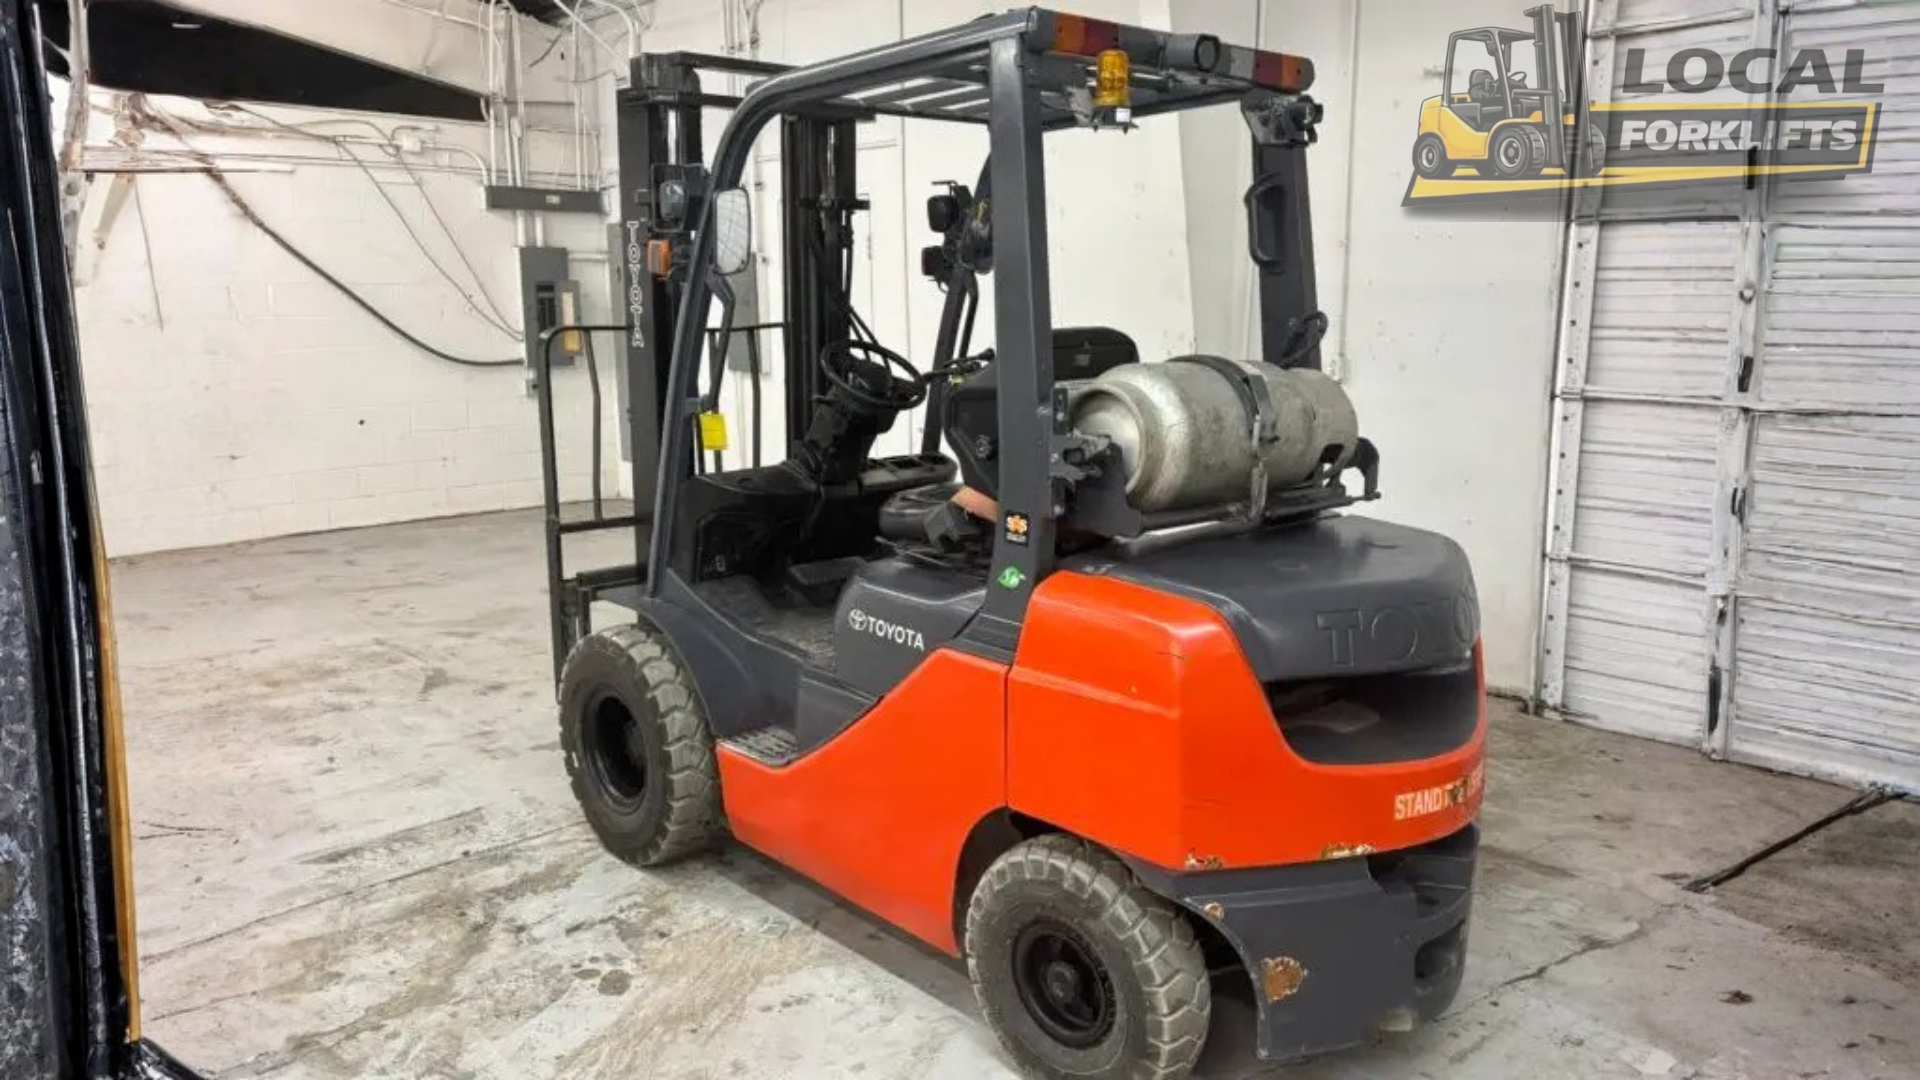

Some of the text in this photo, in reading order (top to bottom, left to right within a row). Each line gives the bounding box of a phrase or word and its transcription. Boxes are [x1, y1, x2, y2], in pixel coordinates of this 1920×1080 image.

[626, 220, 644, 348] TOYOTA
[867, 615, 925, 652] TOYOTA
[1394, 787, 1442, 820] STAND
